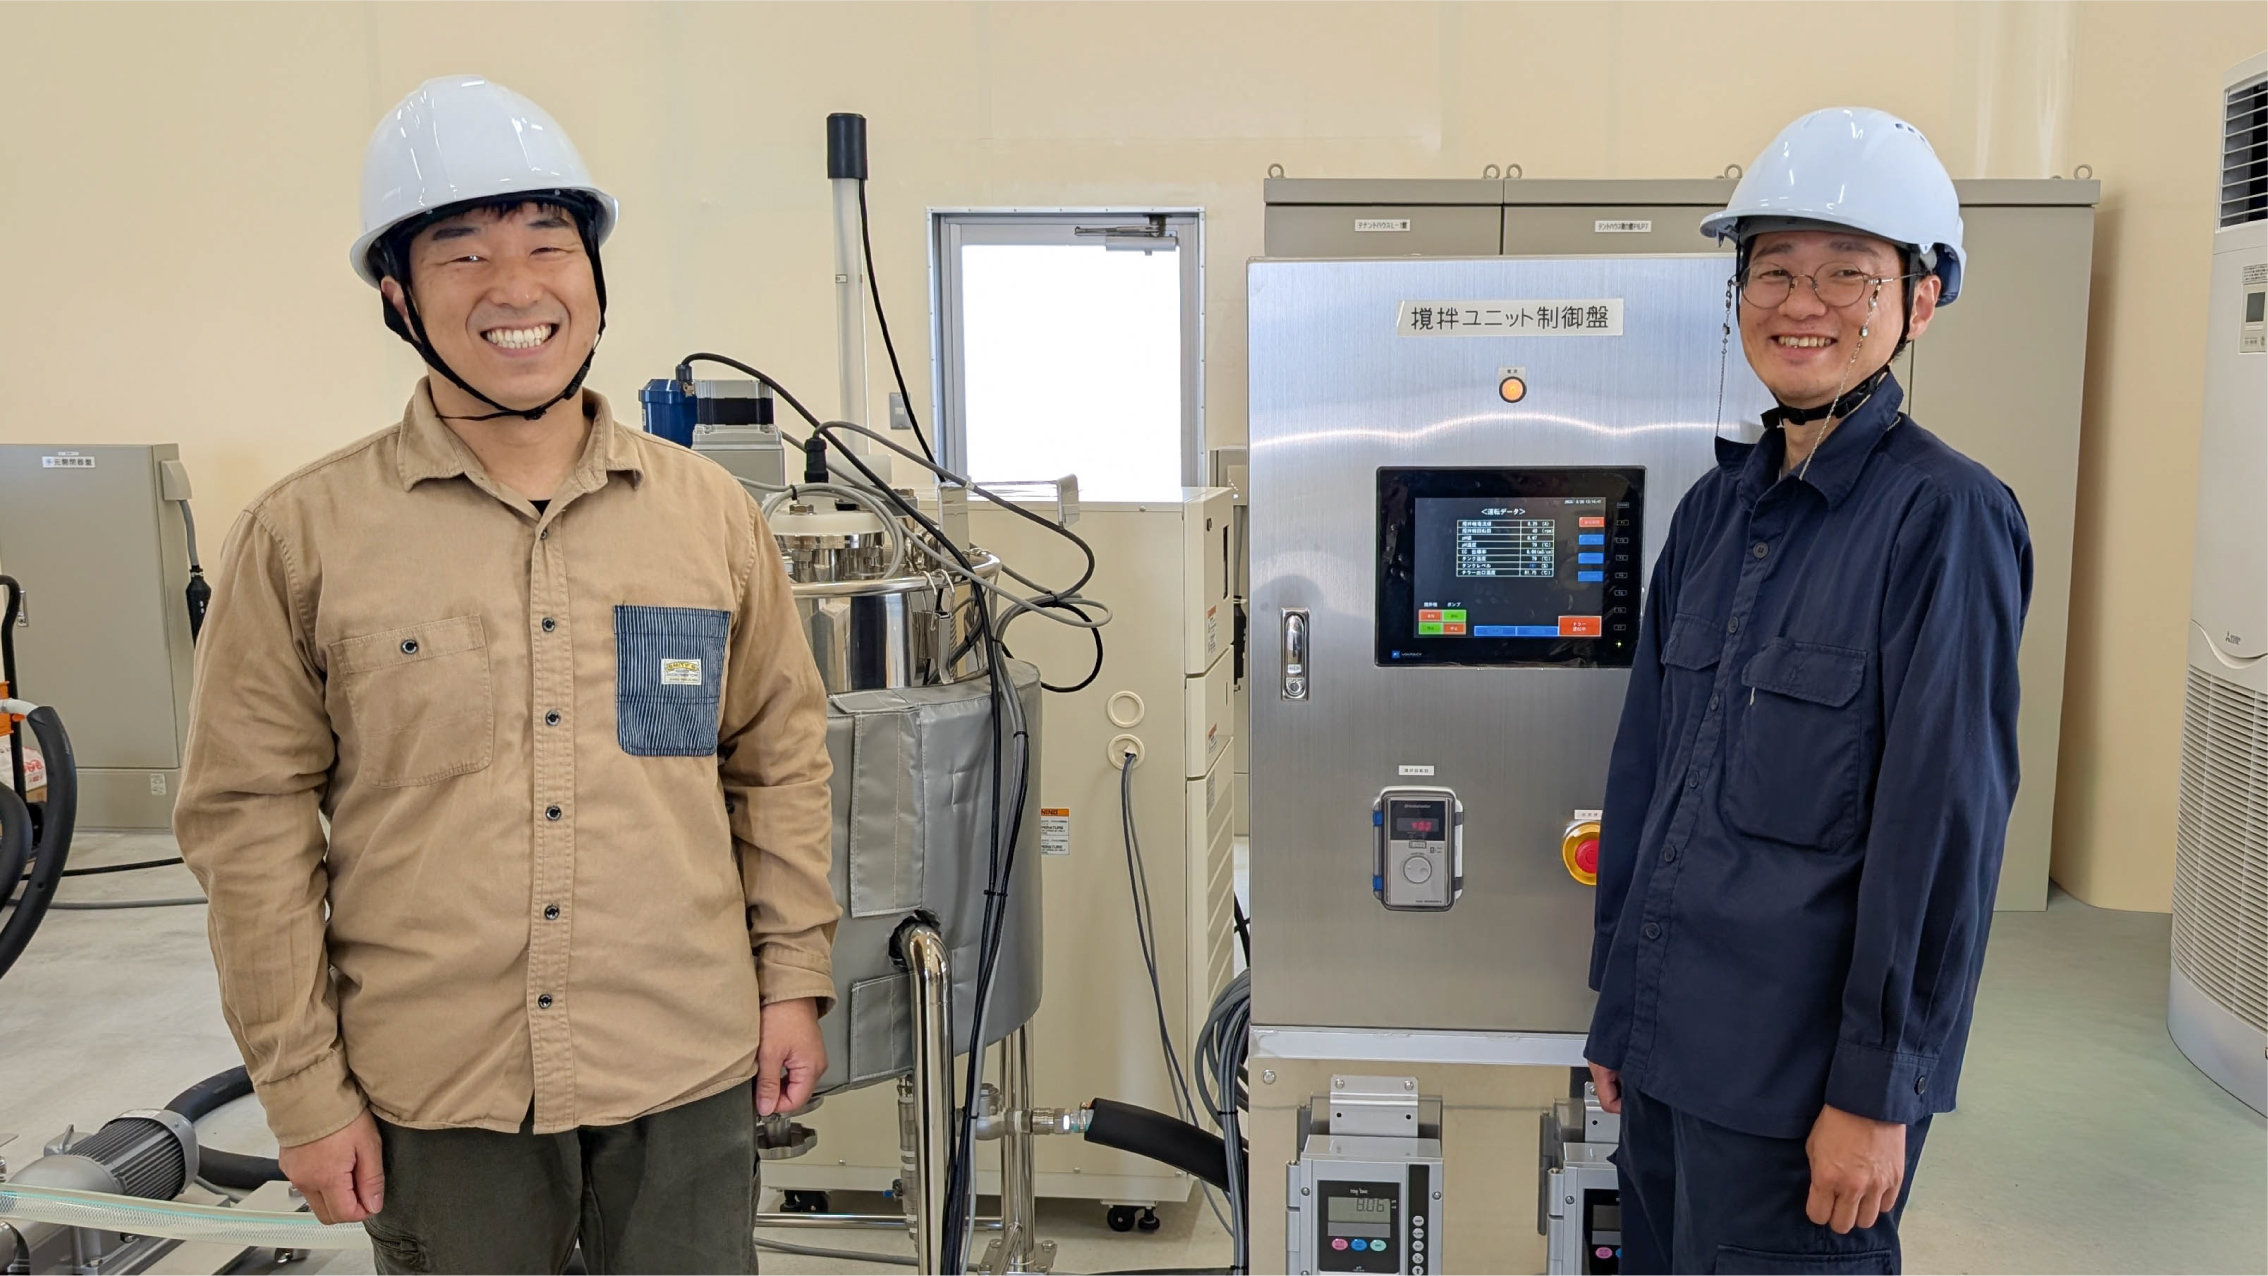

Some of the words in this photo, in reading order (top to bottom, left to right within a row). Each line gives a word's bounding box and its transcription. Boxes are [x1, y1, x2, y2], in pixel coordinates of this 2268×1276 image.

[1410, 305, 1609, 330] 撹拌ユニット制御盤
